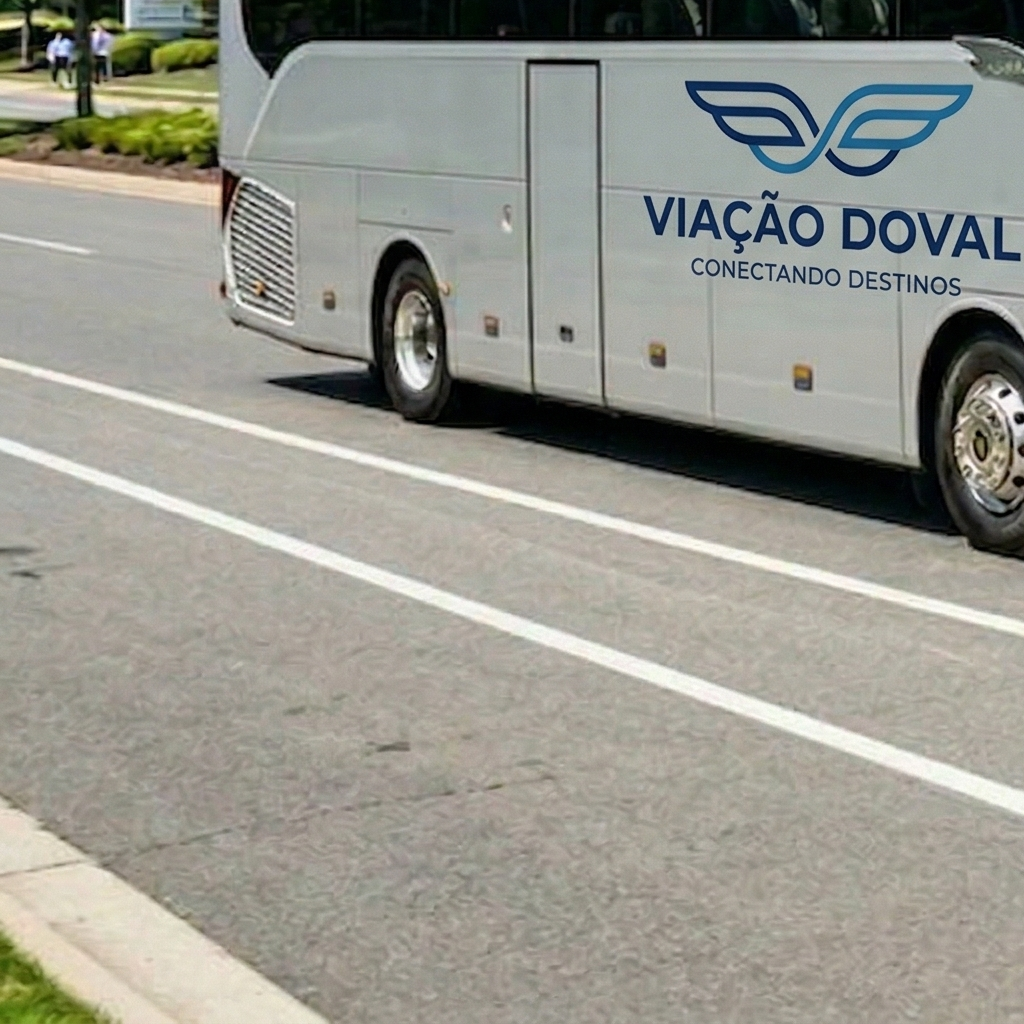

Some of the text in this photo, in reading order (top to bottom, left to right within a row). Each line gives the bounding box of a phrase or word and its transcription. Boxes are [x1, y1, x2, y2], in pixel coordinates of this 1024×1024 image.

[643, 189, 1022, 262] VIAÇÃO DOVAL
[690, 257, 962, 297] CONECTANDO DESTINOS
